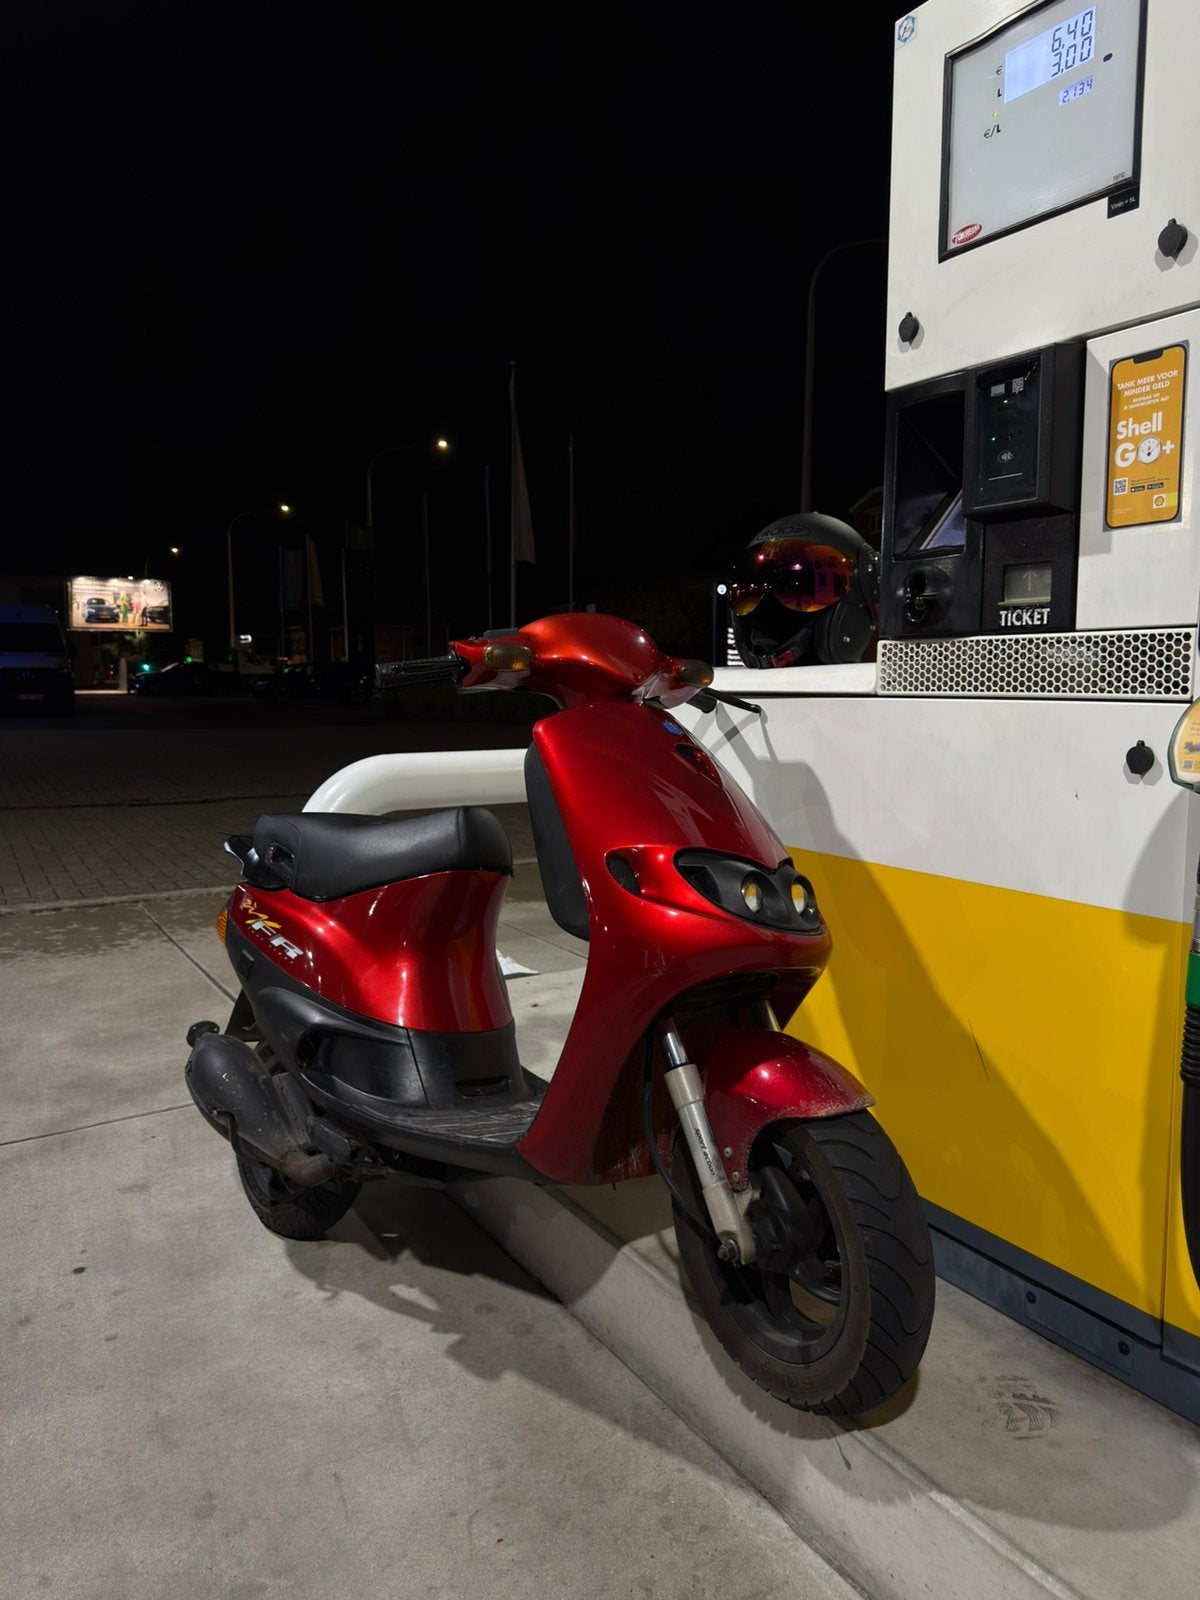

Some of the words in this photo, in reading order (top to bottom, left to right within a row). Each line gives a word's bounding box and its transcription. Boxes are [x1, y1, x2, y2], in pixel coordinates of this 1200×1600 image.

[1116, 380, 1136, 391] TANK
[1136, 375, 1155, 386] MEER
[1156, 369, 1178, 380] VOOR
[1123, 385, 1151, 397] MINDER
[1152, 380, 1170, 391] GELD
[1116, 411, 1163, 440] Shell
[1000, 608, 1051, 626] TICKET
